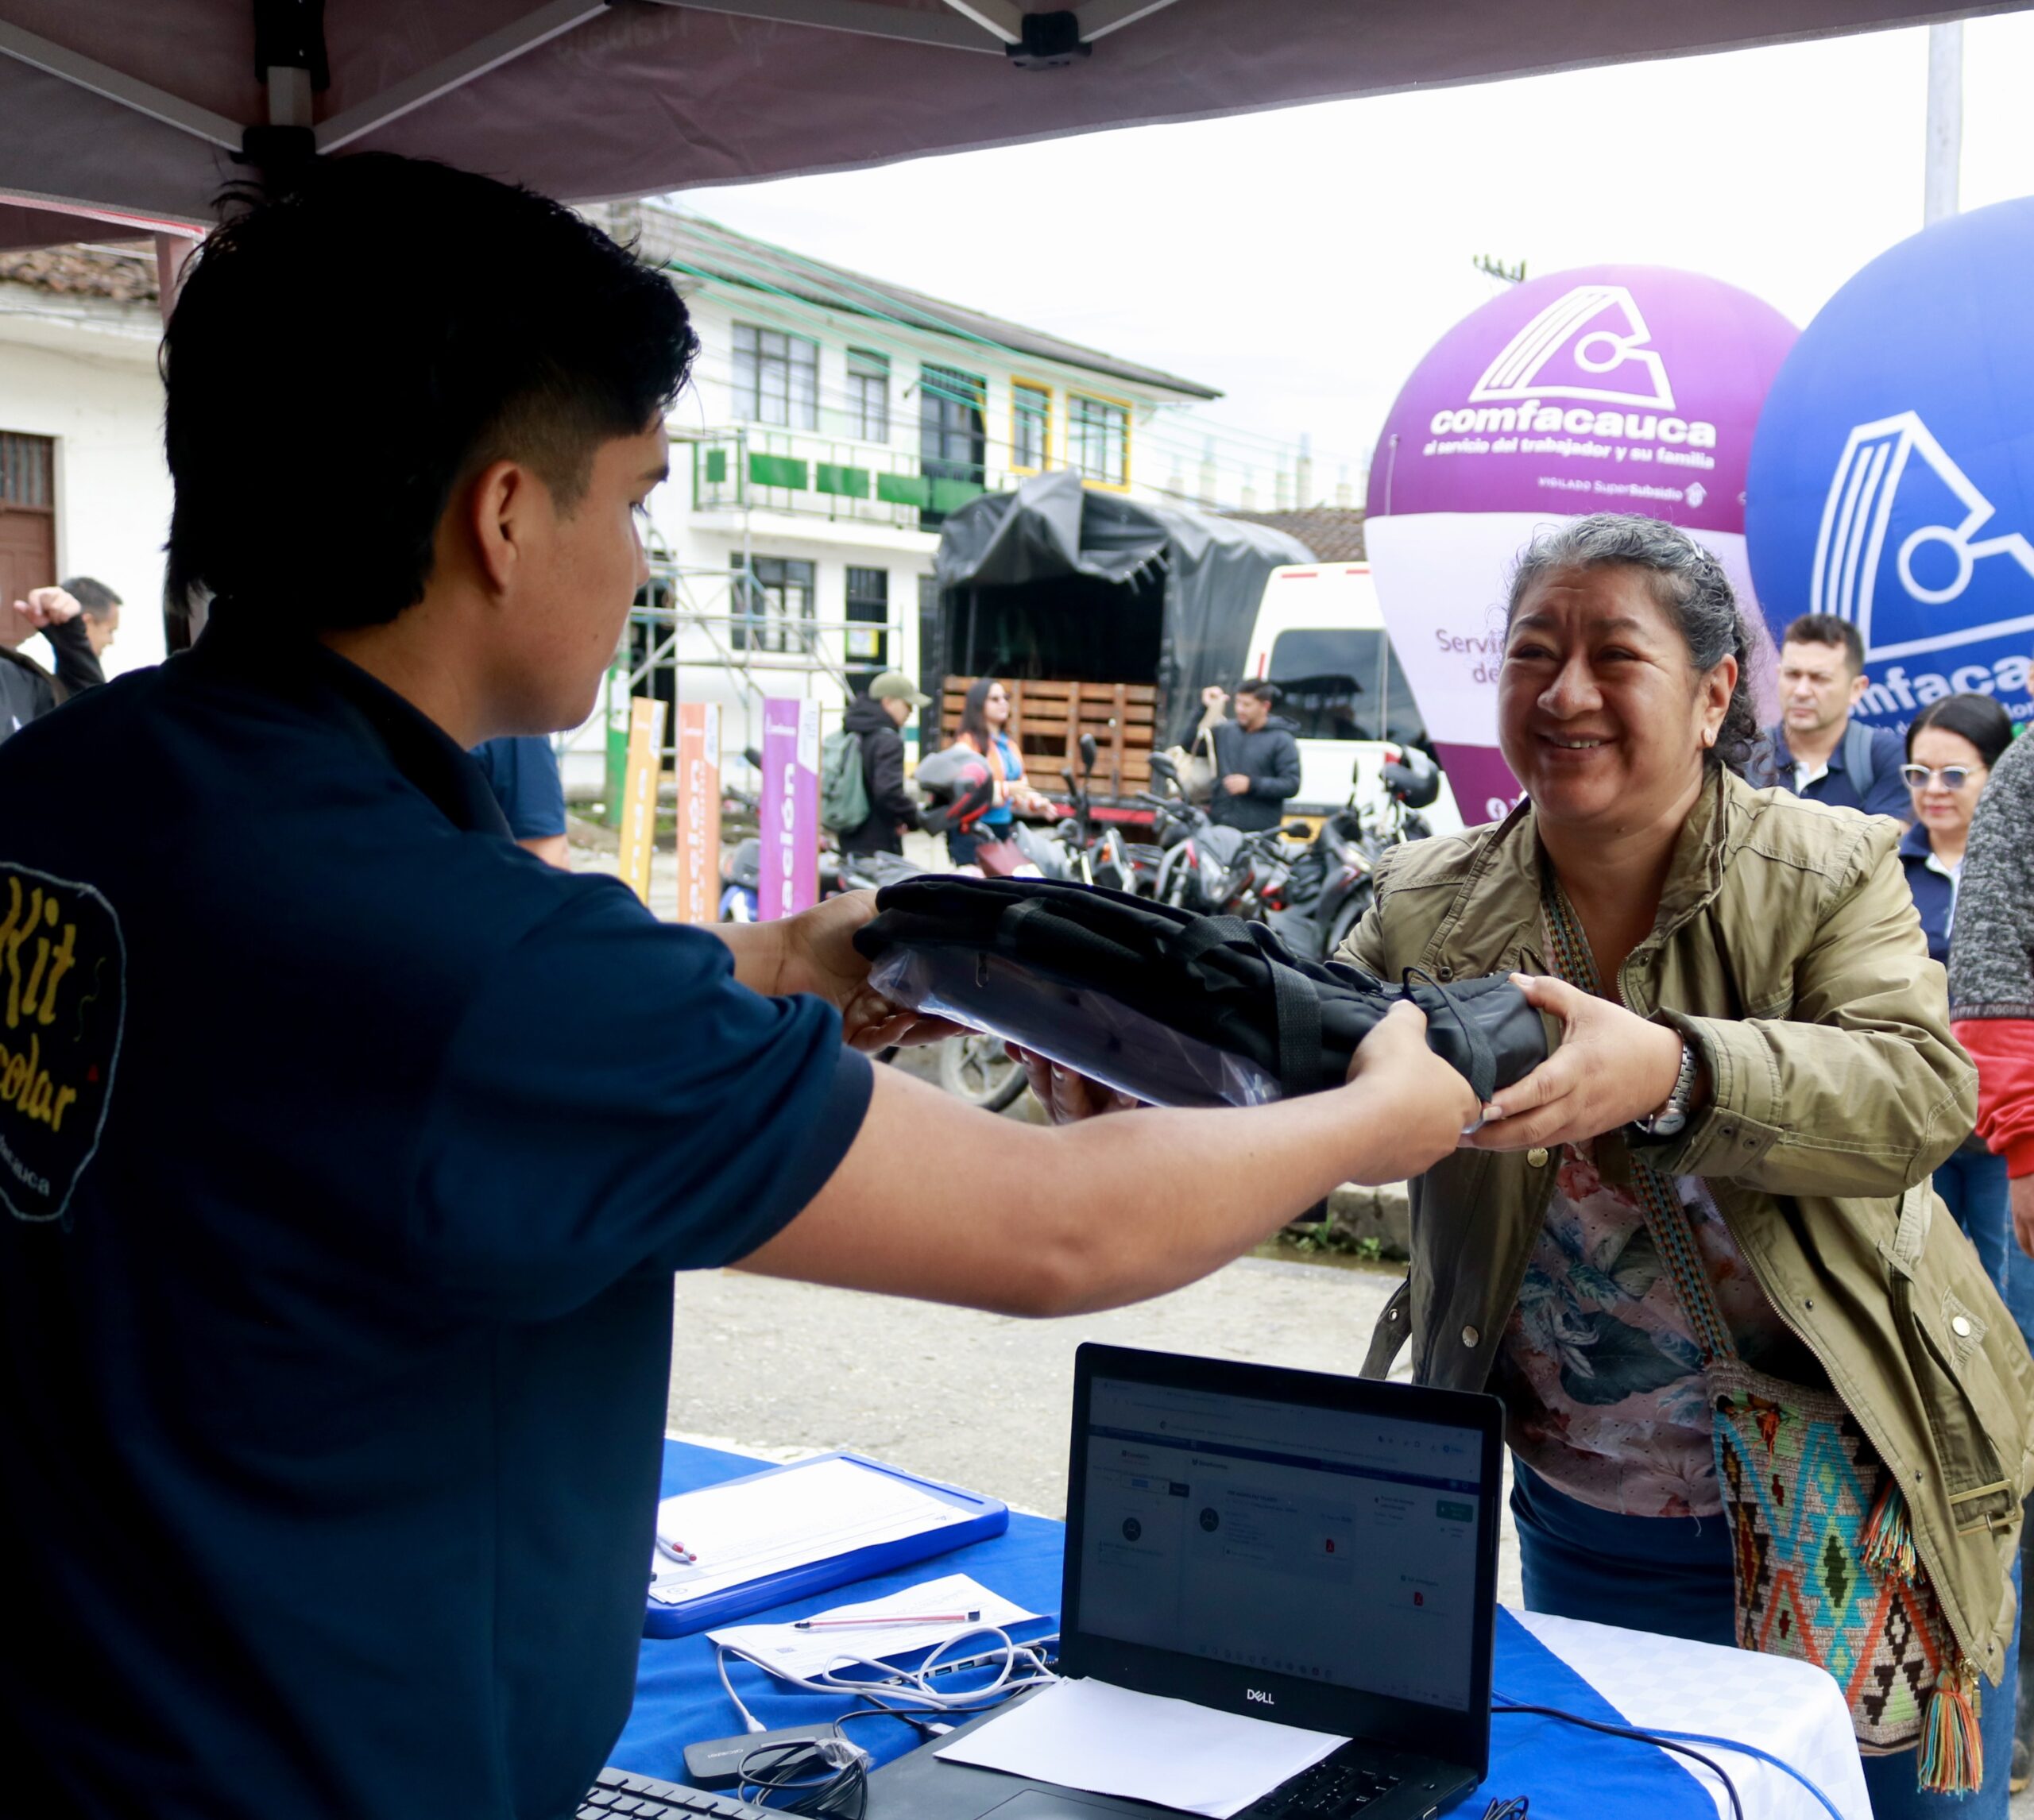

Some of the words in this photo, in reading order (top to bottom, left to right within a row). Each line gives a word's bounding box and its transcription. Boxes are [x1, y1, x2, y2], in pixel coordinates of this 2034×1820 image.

[1430, 399, 1717, 448] comfacauca
[1423, 439, 1437, 456] al
[1437, 437, 1490, 455] servicio
[1491, 436, 1518, 454] del
[1520, 436, 1612, 458] trabajador
[1614, 446, 1627, 462] y
[1630, 447, 1653, 462] su
[1656, 446, 1715, 469] familia
[1537, 476, 1591, 492] VIGILADO
[1435, 628, 1504, 654] Servi
[0, 875, 76, 1030] Kit
[1247, 1688, 1274, 1705] DELL
